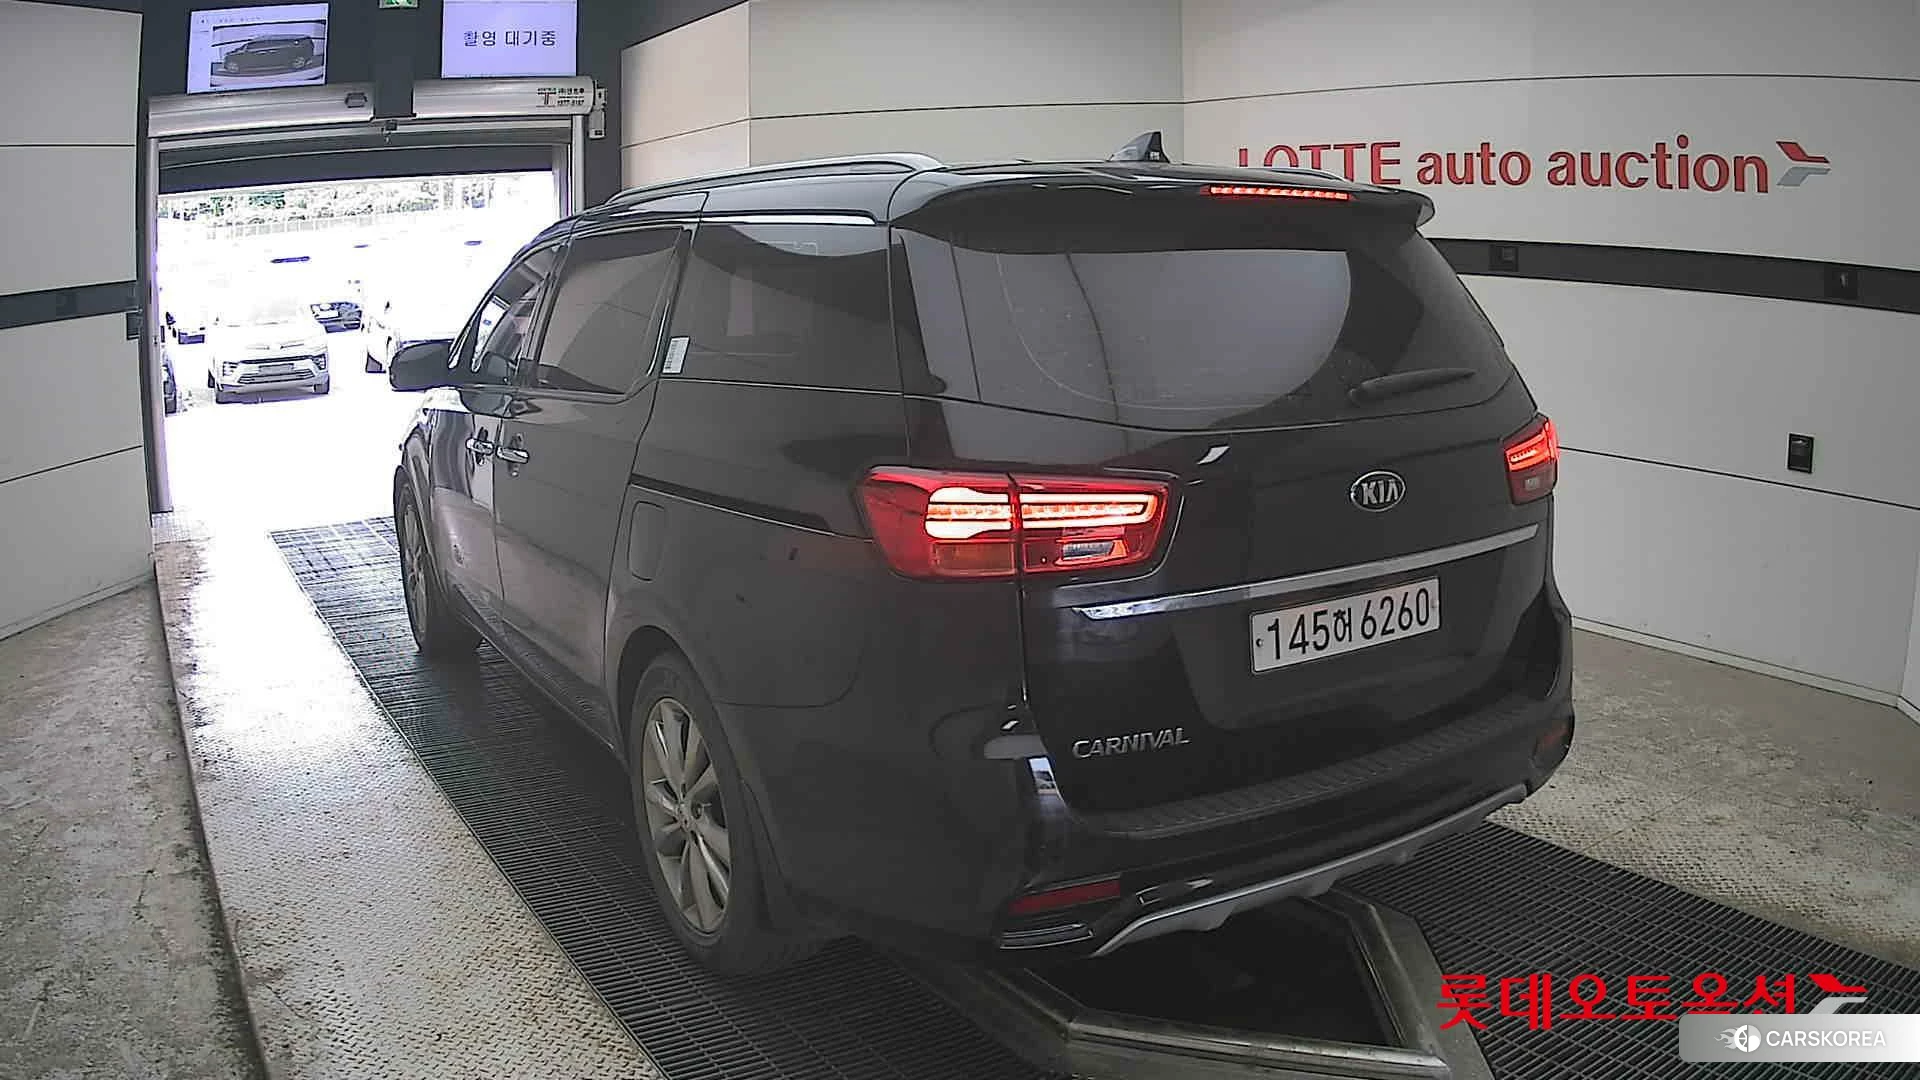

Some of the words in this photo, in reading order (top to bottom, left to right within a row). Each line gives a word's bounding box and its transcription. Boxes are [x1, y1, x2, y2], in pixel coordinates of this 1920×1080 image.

[505, 30, 556, 47] 대기중
[1416, 142, 1531, 187] auto
[1547, 134, 1769, 194] auction
[1361, 478, 1399, 505] KIA
[1072, 727, 1190, 759] CARNIVAL
